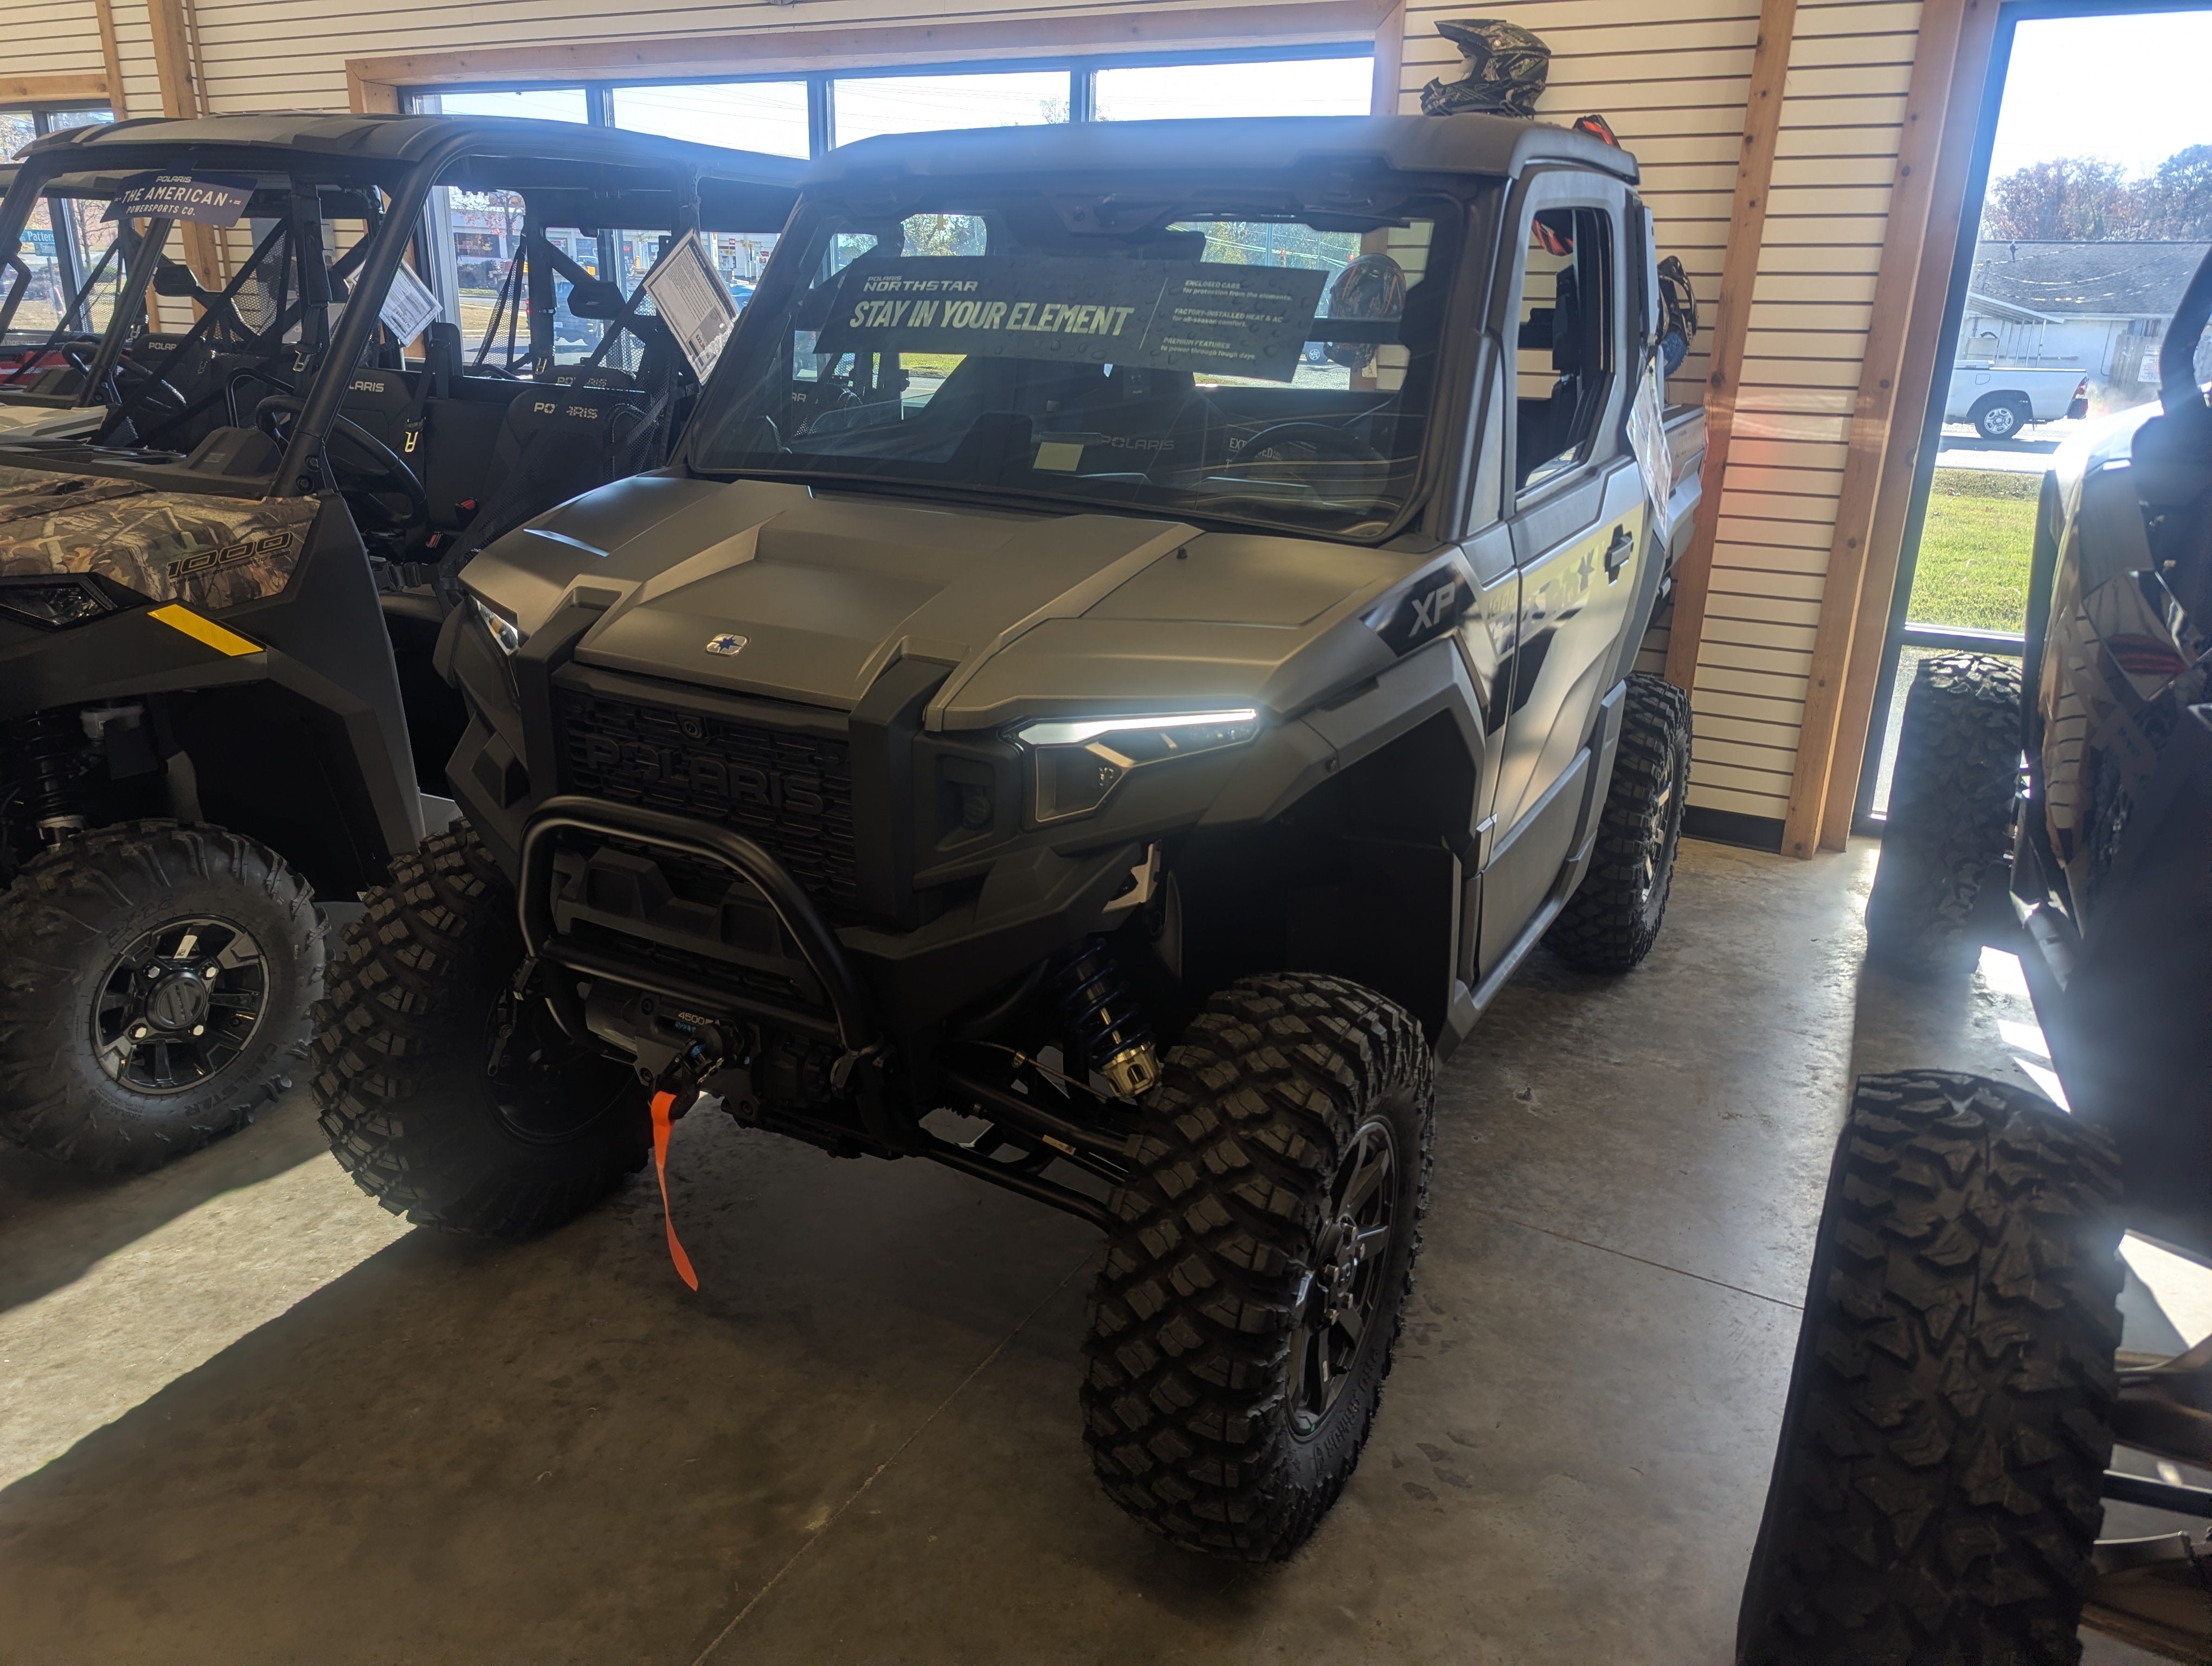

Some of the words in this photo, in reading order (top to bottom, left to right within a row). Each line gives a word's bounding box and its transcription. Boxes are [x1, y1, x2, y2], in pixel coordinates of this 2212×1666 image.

[122, 188, 145, 204] THE
[144, 187, 228, 207] AMERICAN
[126, 204, 178, 214] POWERSPORTS
[181, 207, 196, 216] CO.
[28, 231, 55, 241] Patters
[863, 281, 978, 292] NORTHSTAR
[1185, 280, 1221, 288] ENCLOSED
[850, 300, 911, 328] STAY
[907, 300, 940, 327] IN
[940, 301, 1007, 329] YOUR
[1006, 303, 1135, 336] ELEMENT
[1174, 308, 1245, 319] FACTORY-INSTALLED
[1182, 317, 1217, 325] all-season
[148, 342, 178, 351] POLAR
[1163, 337, 1193, 345] PREMIUM
[1194, 340, 1230, 349] FEATURES
[1191, 348, 1217, 357] through
[1218, 350, 1238, 358] tough
[349, 381, 384, 393] ARIS
[557, 377, 607, 387] PORIS
[534, 402, 599, 419] POARIS
[1101, 435, 1175, 451] POLARIS
[166, 531, 293, 579] 1000
[1409, 582, 1456, 638] XP
[585, 733, 825, 816] POLARIS
[678, 1011, 705, 1026] 4500
[184, 1042, 278, 1117] CARLSTAR
